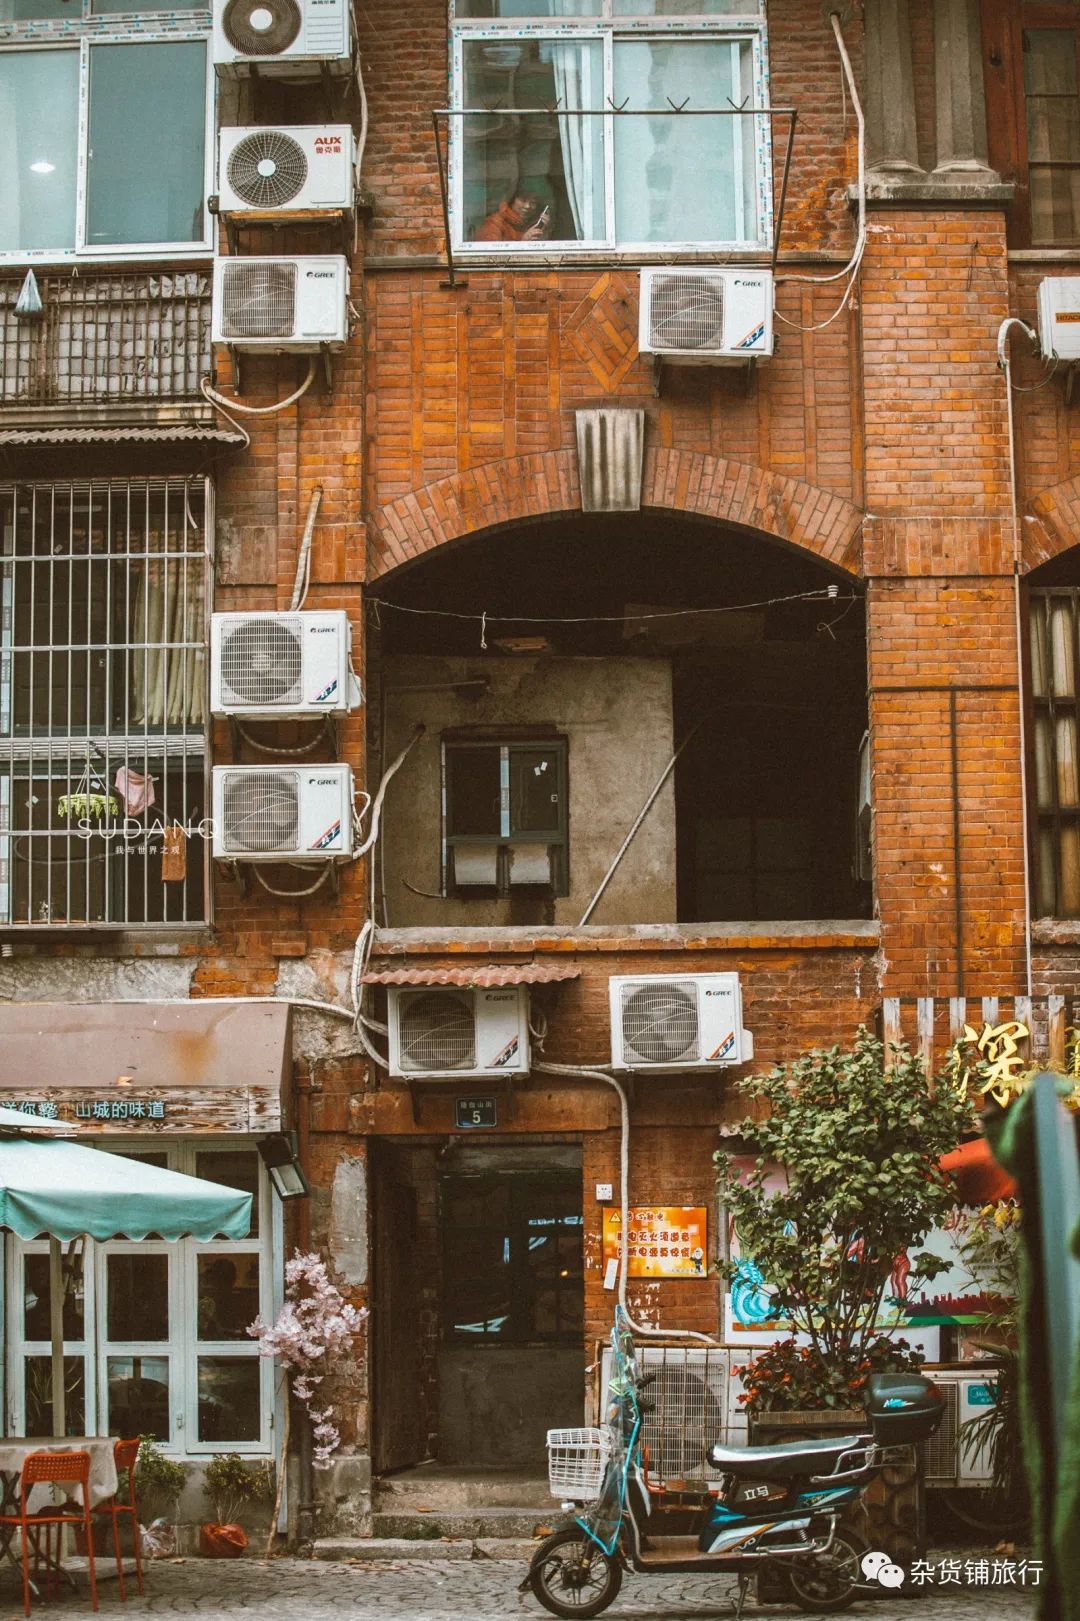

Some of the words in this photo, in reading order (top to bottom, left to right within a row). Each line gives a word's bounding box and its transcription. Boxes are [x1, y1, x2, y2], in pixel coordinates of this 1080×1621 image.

[314, 136, 342, 145] AUX
[76, 1100, 165, 1119] 山城的味道
[472, 1110, 481, 1124] 5
[744, 1485, 769, 1501] 立马
